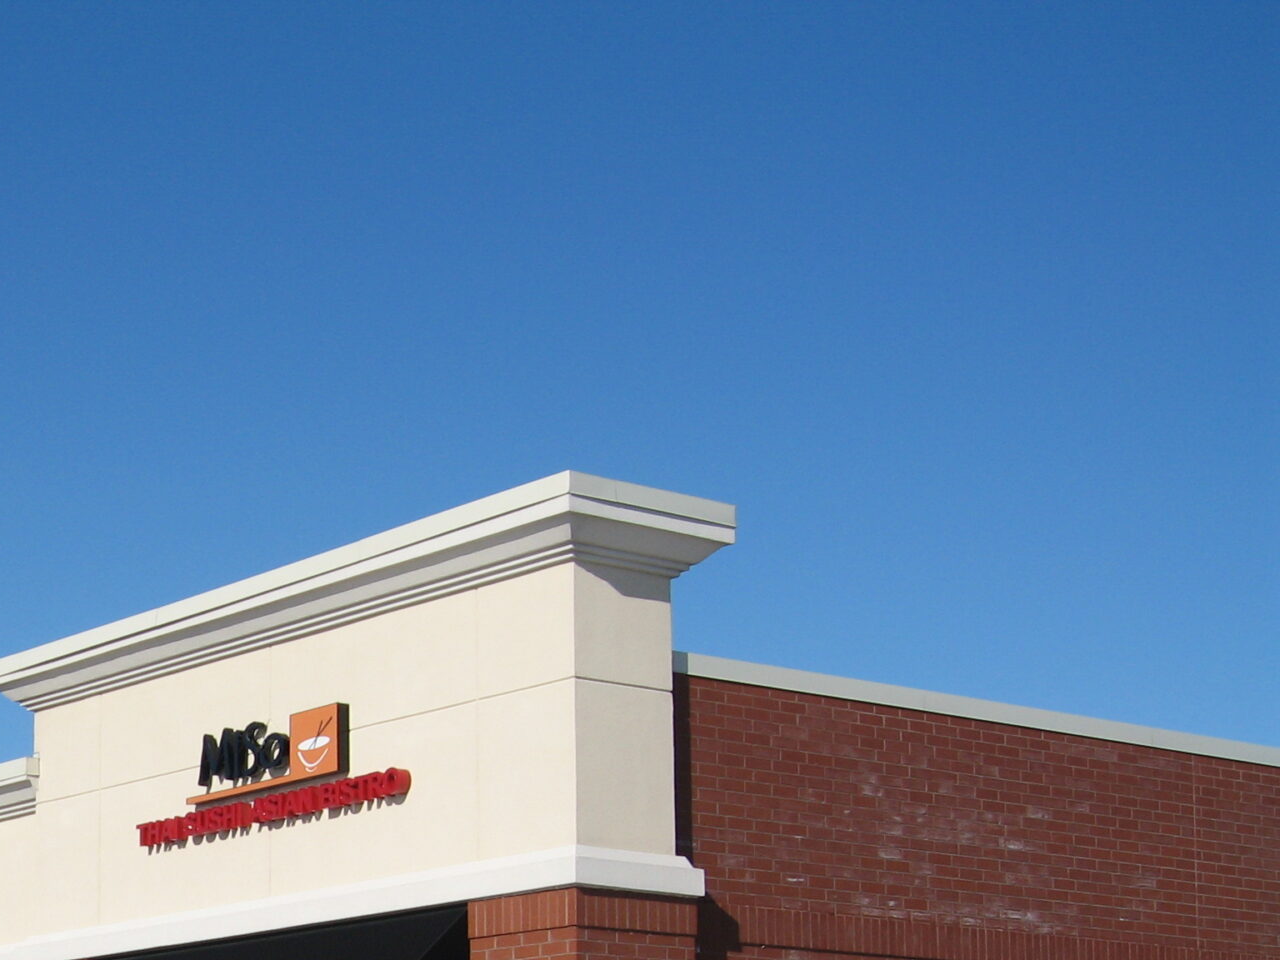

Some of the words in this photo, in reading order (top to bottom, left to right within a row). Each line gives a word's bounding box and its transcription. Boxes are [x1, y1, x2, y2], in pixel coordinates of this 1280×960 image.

[136, 816, 186, 847] THAI
[185, 802, 252, 836] SUSHI
[252, 786, 323, 824] ASIAN
[322, 767, 412, 809] BISTRO
